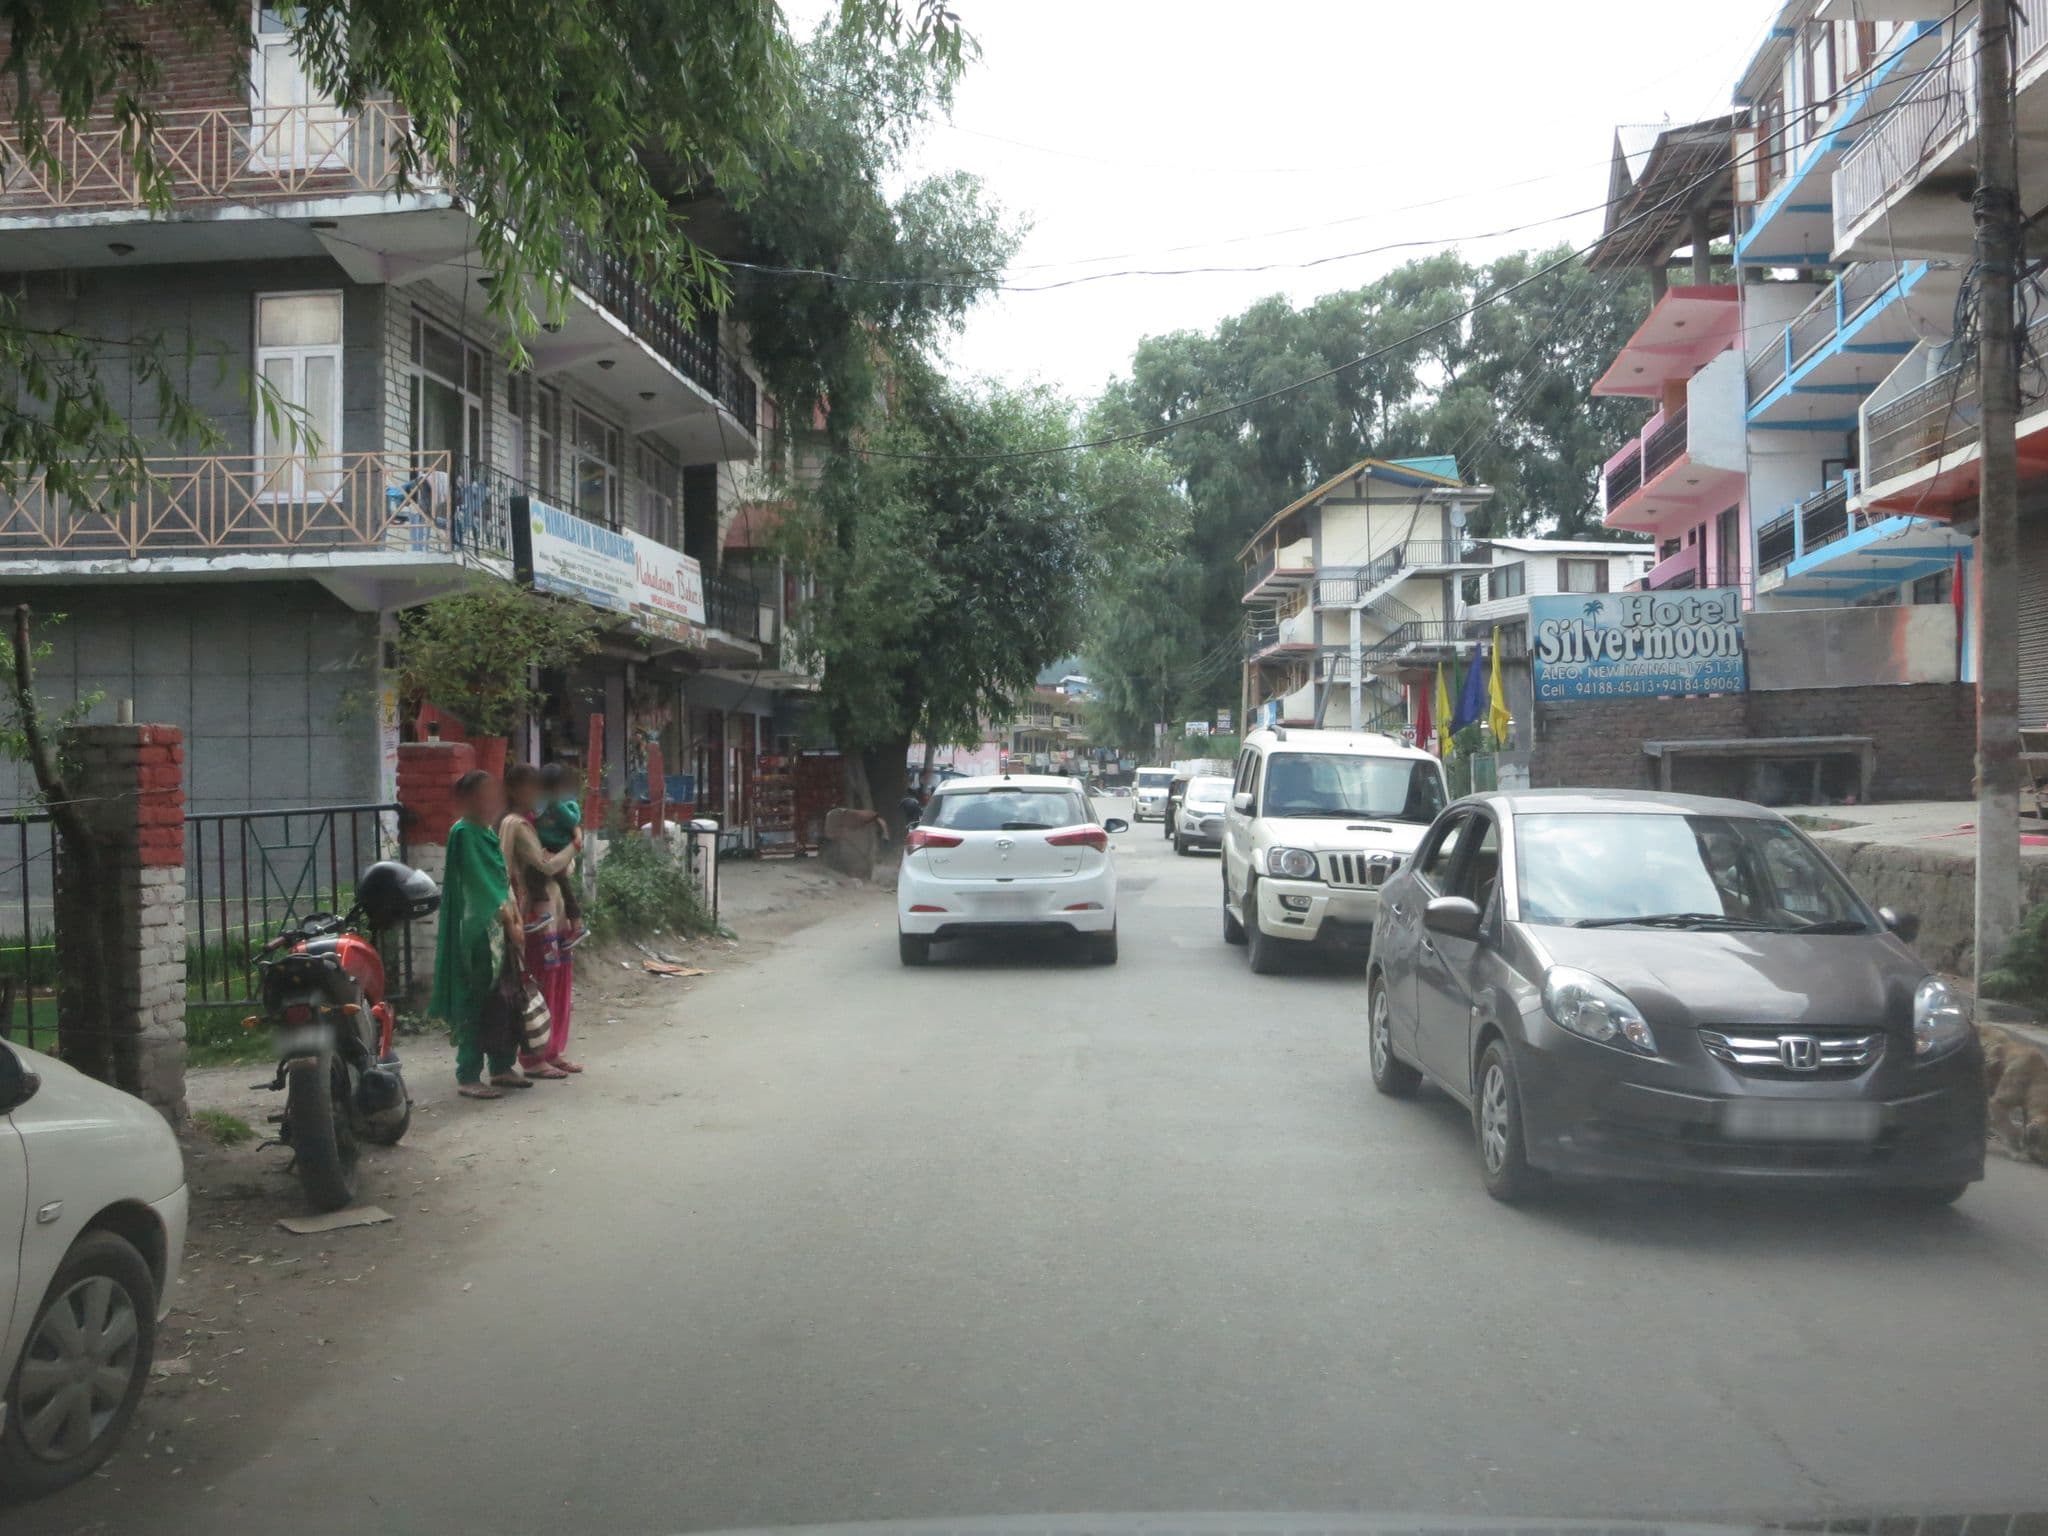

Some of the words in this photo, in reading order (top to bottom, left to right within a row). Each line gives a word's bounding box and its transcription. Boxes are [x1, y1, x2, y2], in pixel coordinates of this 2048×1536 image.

[545, 505, 592, 549] HIMALAYAN
[1620, 592, 1739, 627] Hotel
[1538, 618, 1740, 664] Silvermoon
[1541, 684, 1565, 696] Cell
[1576, 680, 1654, 694] 94188-45413
[1662, 676, 1741, 691] 94184-89062
[1588, 665, 1622, 678] NEW
[1625, 661, 1740, 676] MANALI-175131
